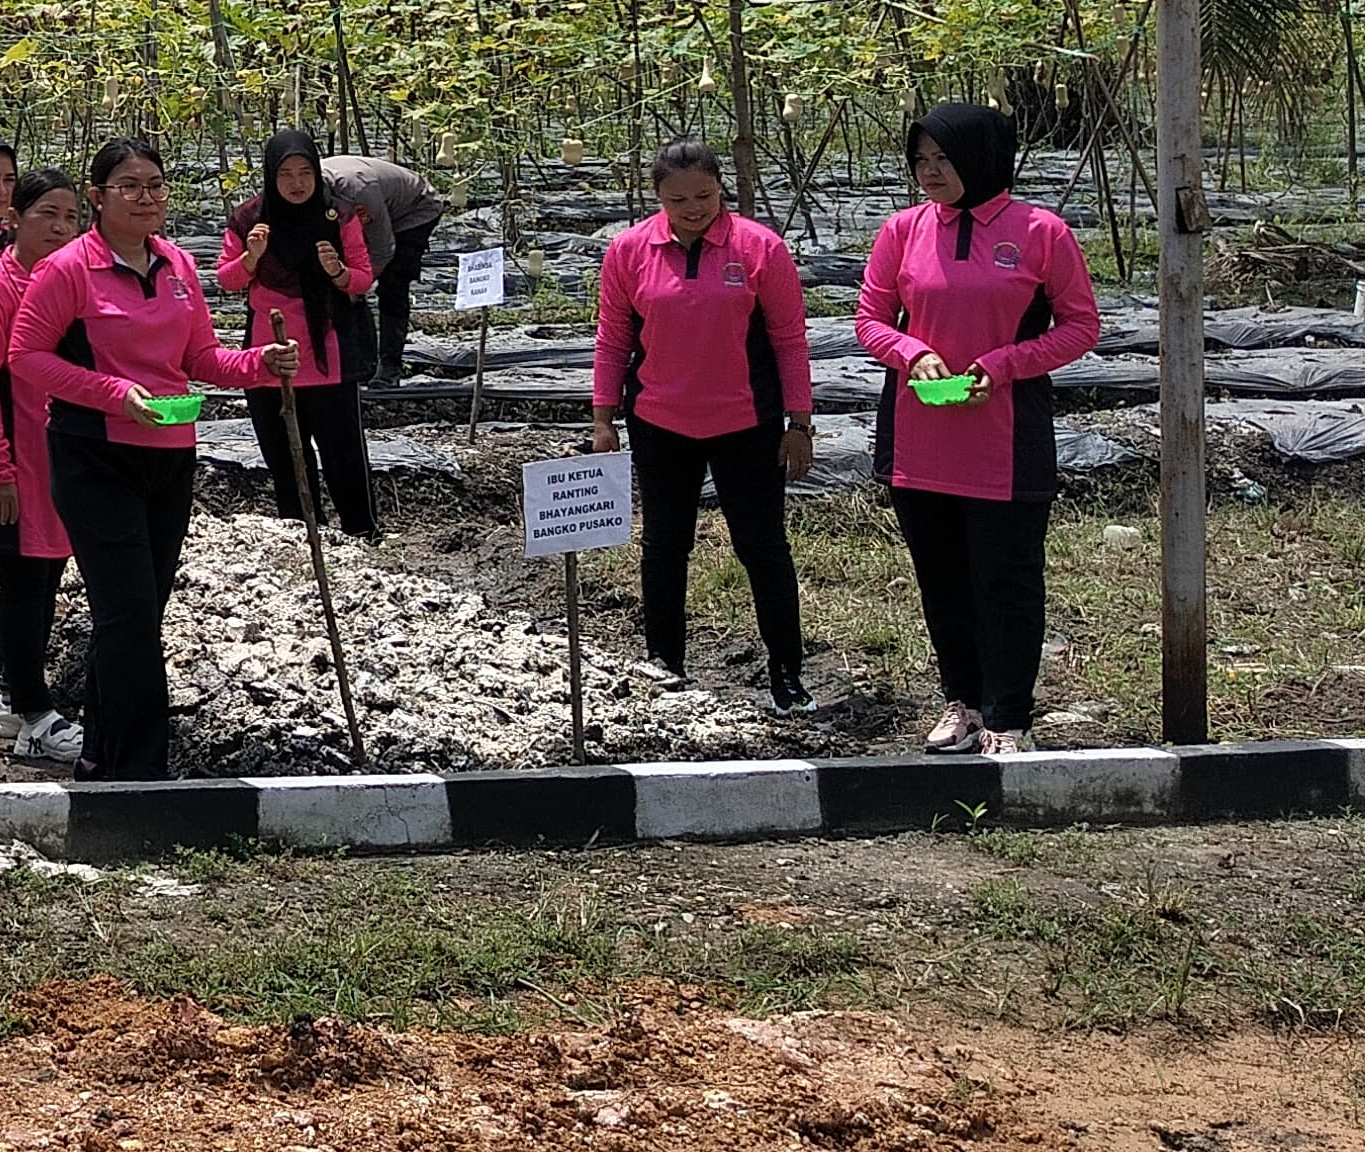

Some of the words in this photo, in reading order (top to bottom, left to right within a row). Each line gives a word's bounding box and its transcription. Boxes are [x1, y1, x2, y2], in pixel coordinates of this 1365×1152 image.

[547, 472, 566, 485] IBU
[568, 467, 604, 482] KETUA
[552, 485, 599, 501] RANTING
[538, 500, 615, 521] BHAYANGKARI
[533, 523, 577, 539] BANGKO
[579, 516, 623, 532] PUSAKO
